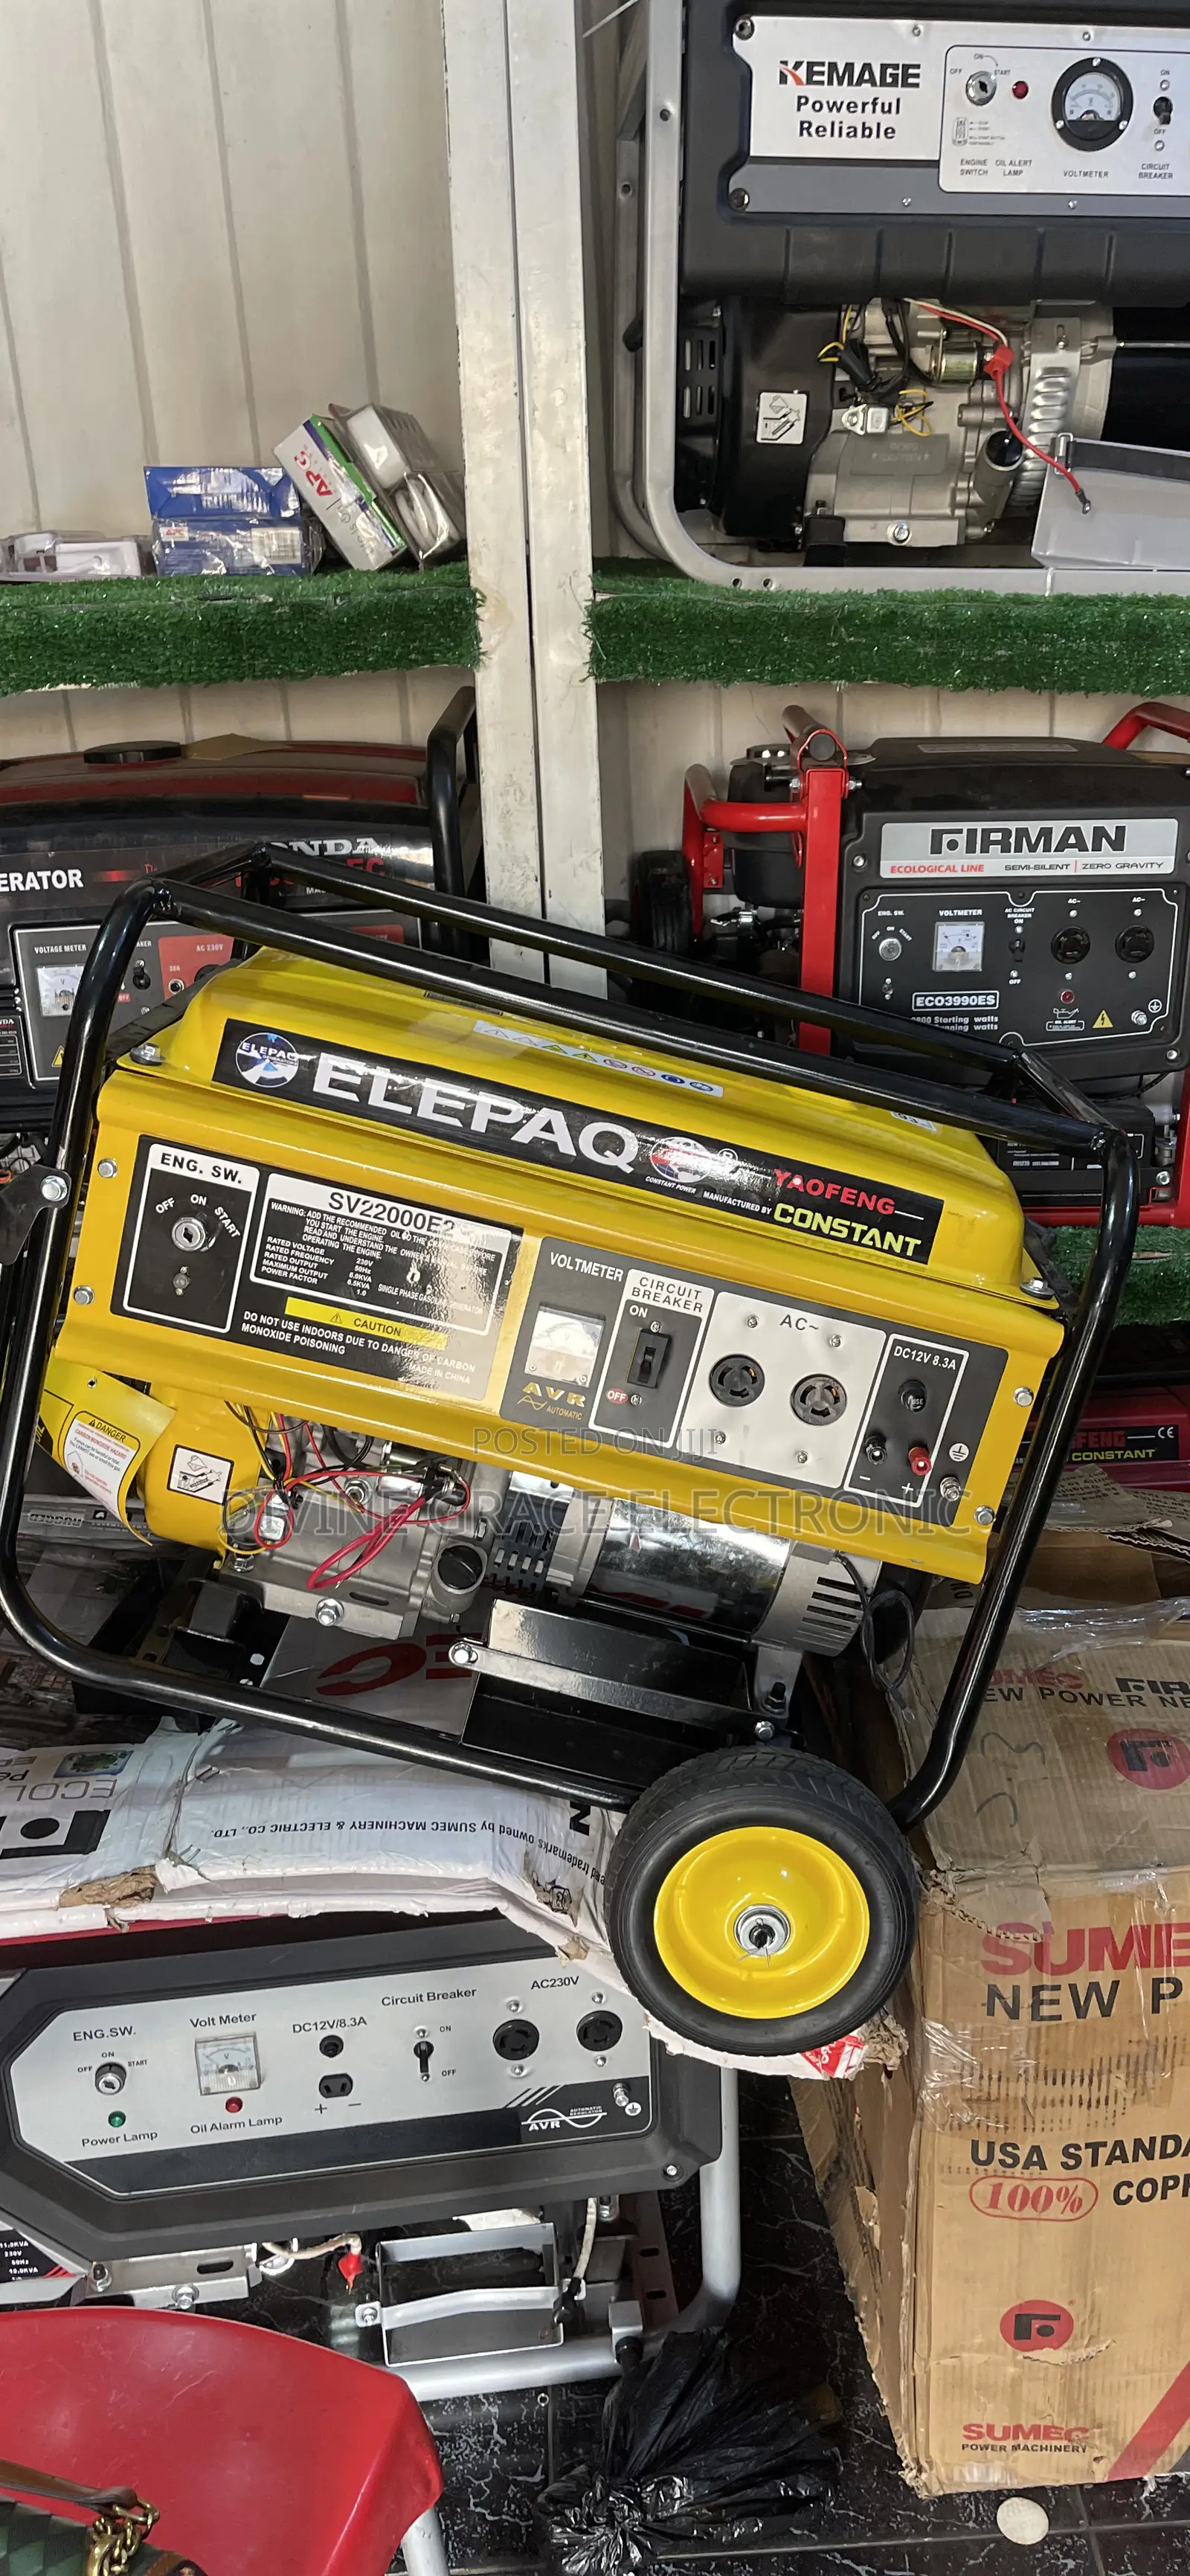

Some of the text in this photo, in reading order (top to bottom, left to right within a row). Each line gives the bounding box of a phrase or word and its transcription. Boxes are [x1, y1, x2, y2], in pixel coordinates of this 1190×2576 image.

[779, 60, 921, 89] KEMAGE
[796, 95, 901, 115] Powerful
[799, 120, 896, 140] Reliable
[959, 168, 988, 176] SWITCH
[930, 826, 1125, 854] FIRMAN
[890, 864, 985, 874] ECOLOGICAL LINE
[1005, 863, 1070, 871] SEMI-SILENT
[1116, 861, 1164, 870] GRAVITY
[34, 943, 87, 954] VOLTAGE METER
[916, 995, 995, 1006] ECO3990ES
[934, 1016, 970, 1024] Starting
[312, 1052, 640, 1173] ELEPAQ
[161, 1152, 243, 1184] ENG. SW.
[646, 1176, 697, 1194] CONSTANT POWER
[774, 1167, 896, 1215] YAOFENG
[155, 1197, 176, 1215] OFF
[190, 1193, 207, 1206] ON
[703, 1191, 773, 1215] MANUFACTURED BY
[214, 1206, 242, 1240] START
[271, 1202, 425, 1245] WARNING: ADD THE RECOMMENDED OIL THE
[306, 1218, 385, 1243] YOU START THE ENGINE.
[774, 1203, 922, 1257] CONSTANT
[302, 1234, 382, 1259] OPERATING THE ENGINE.
[303, 1226, 398, 1254] READ AND UNDERSTAND THE
[264, 1251, 288, 1262] RATED
[289, 1257, 318, 1269] OUTPUT
[266, 1244, 372, 1274] RATED FREQUENCY 50Hz
[267, 1236, 373, 1267] RATED VOLTAGE 230V
[261, 1266, 288, 1278] POWER
[289, 1273, 318, 1285] FACTOR
[263, 1259, 298, 1272] MAXIMUM
[299, 1267, 328, 1279] OUTPUT
[550, 1252, 624, 1282] VOLTMETER
[378, 1283, 419, 1300] SINGLE PHASE
[639, 1276, 703, 1301] CIRCUIT
[631, 1287, 704, 1314] BREAKER
[629, 1305, 649, 1318] ON
[353, 1317, 402, 1337] CAUTION
[241, 1322, 346, 1355] MONOXIDE POISONING
[243, 1311, 476, 1373] DO NOT USE INDOORS DUE TO DANGER OF CARBON
[893, 1346, 956, 1370] DC12V 8.3A
[409, 1363, 471, 1384] MADE IN CHINA
[522, 1382, 586, 1407] AVR
[607, 1391, 627, 1402] OFF
[547, 1405, 583, 1421] AUTOMATIC
[95, 1422, 126, 1443] DANGER
[1072, 1450, 1155, 1461] CONSTANT
[1039, 1686, 1148, 1708] POWER
[210, 1828, 237, 1838] LTD.
[270, 1822, 331, 1834] ELECTRIC
[336, 1821, 346, 1831] &
[350, 1820, 427, 1831] MACHINERY
[431, 1822, 477, 1833] SUMEC
[480, 1820, 495, 1833] by
[499, 1824, 535, 1845] owned
[538, 1838, 589, 1875] trademarks
[530, 1976, 580, 1991] AC230V
[381, 1987, 477, 2007] Circuit Breaker
[985, 1976, 1184, 2022] NEW P
[190, 2013, 257, 2029] Volt Meter
[292, 2016, 367, 2034] DC12V/8.3A
[73, 2026, 136, 2042] ENG.SW.
[128, 2059, 147, 2068] START
[441, 2069, 457, 2077] OFF
[190, 2115, 283, 2134] Oil Alarm Lamp
[529, 2121, 561, 2131] AVR
[82, 2130, 158, 2148] Power Lamp
[970, 2139, 1048, 2171] USA
[984, 2182, 1084, 2215] 100%
[962, 2424, 1090, 2442] SUMEC
[962, 2444, 1087, 2454] POWER MACHINERY
